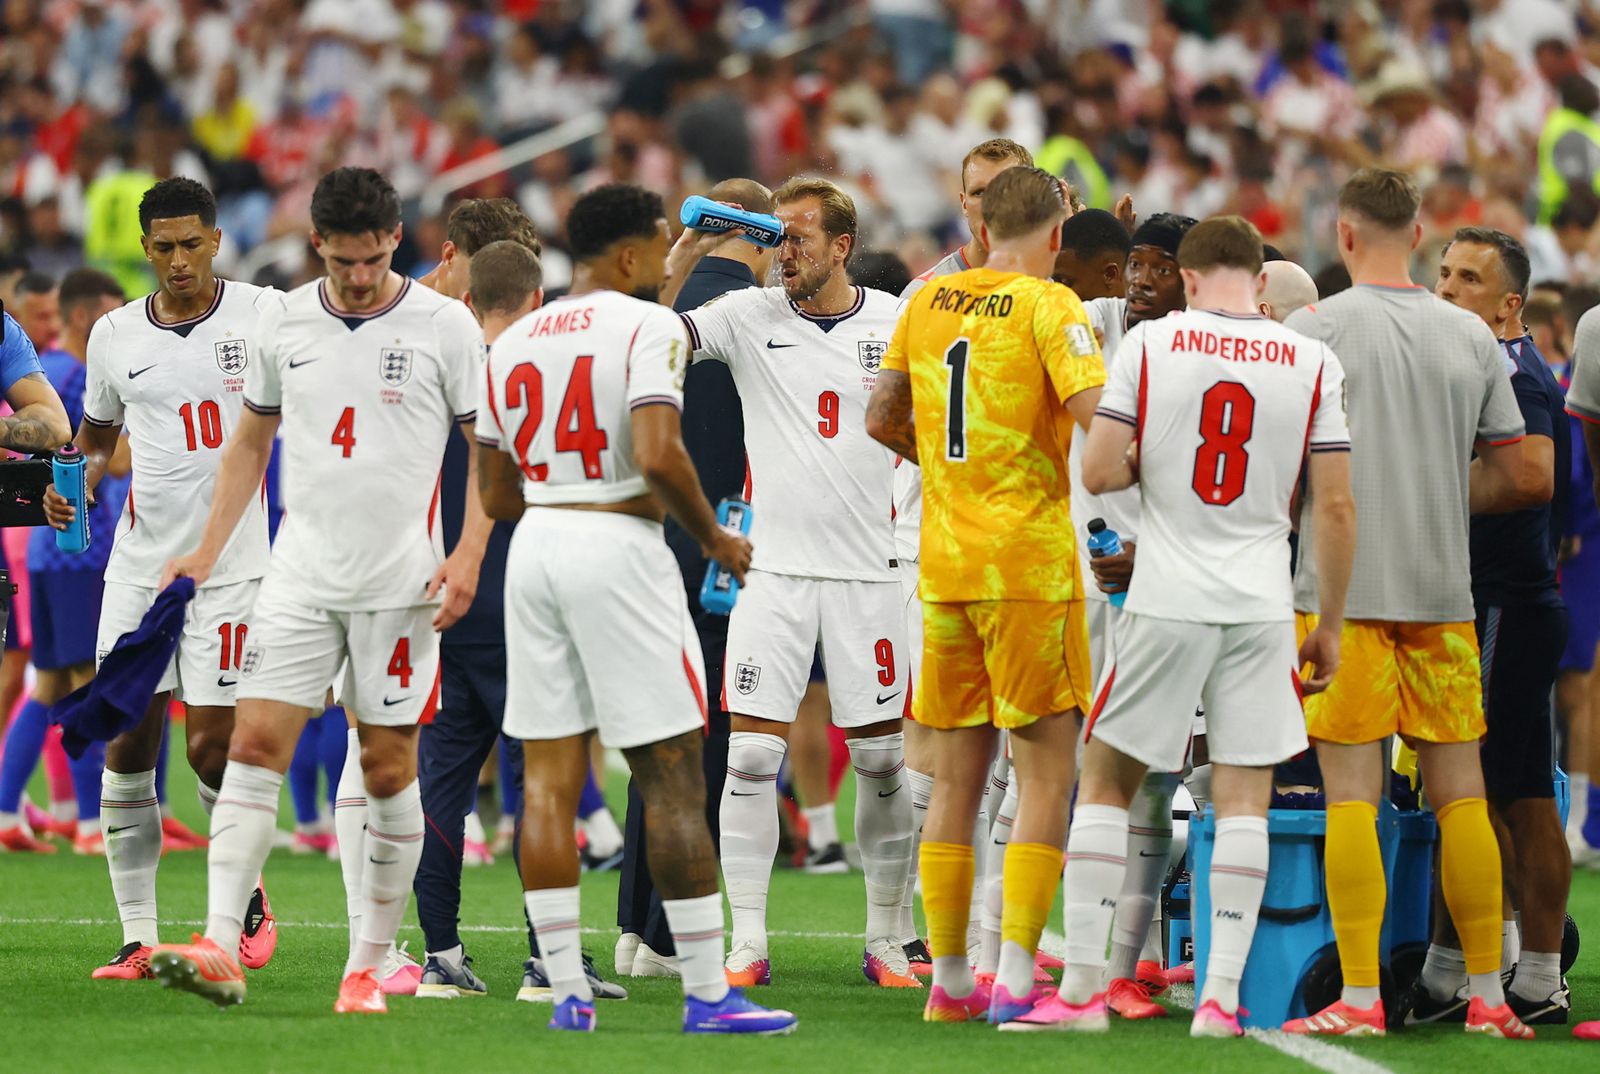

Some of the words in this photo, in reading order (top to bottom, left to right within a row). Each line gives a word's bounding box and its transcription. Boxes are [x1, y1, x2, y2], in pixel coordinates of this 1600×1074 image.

[528, 306, 595, 339] JAMES
[930, 287, 1014, 318] PICKFORD
[1171, 329, 1297, 368] ANDERSON
[505, 354, 608, 483] 24
[817, 390, 840, 439] 9
[944, 336, 969, 462] 1
[179, 399, 223, 452] 10
[331, 406, 357, 459] 4
[1191, 380, 1256, 507] 8
[386, 637, 414, 689] 4
[874, 638, 897, 688] 9
